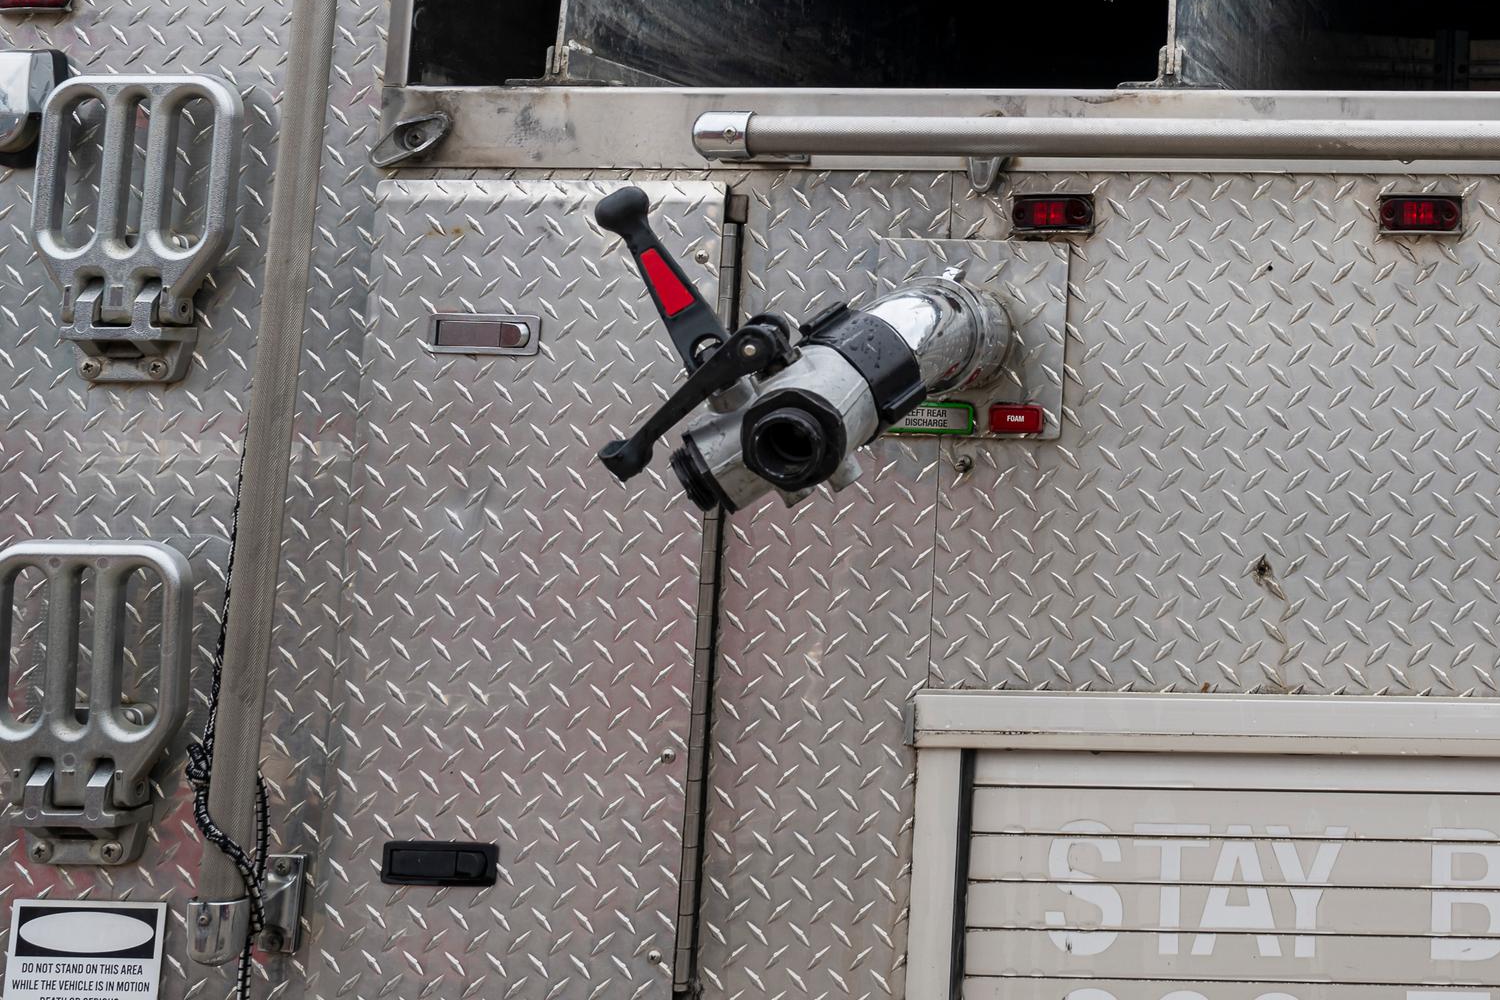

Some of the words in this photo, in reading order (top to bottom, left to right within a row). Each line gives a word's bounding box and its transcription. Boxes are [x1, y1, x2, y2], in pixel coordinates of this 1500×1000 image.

[926, 409, 947, 418] REAR
[1006, 414, 1025, 422] FOAM
[904, 418, 948, 427] DISCHARGE
[1045, 819, 1349, 957] STAY
[21, 962, 34, 973] DO
[35, 963, 54, 974] NOT
[55, 963, 84, 974] STAND
[85, 964, 98, 974] ON
[100, 964, 119, 975] THIS
[120, 964, 143, 975] AREA
[11, 979, 39, 990] WHILE
[40, 979, 57, 990] THE
[59, 980, 94, 991] VEHICLE
[94, 981, 104, 991] IS
[105, 981, 115, 992] IN
[116, 981, 150, 992] MOTION
